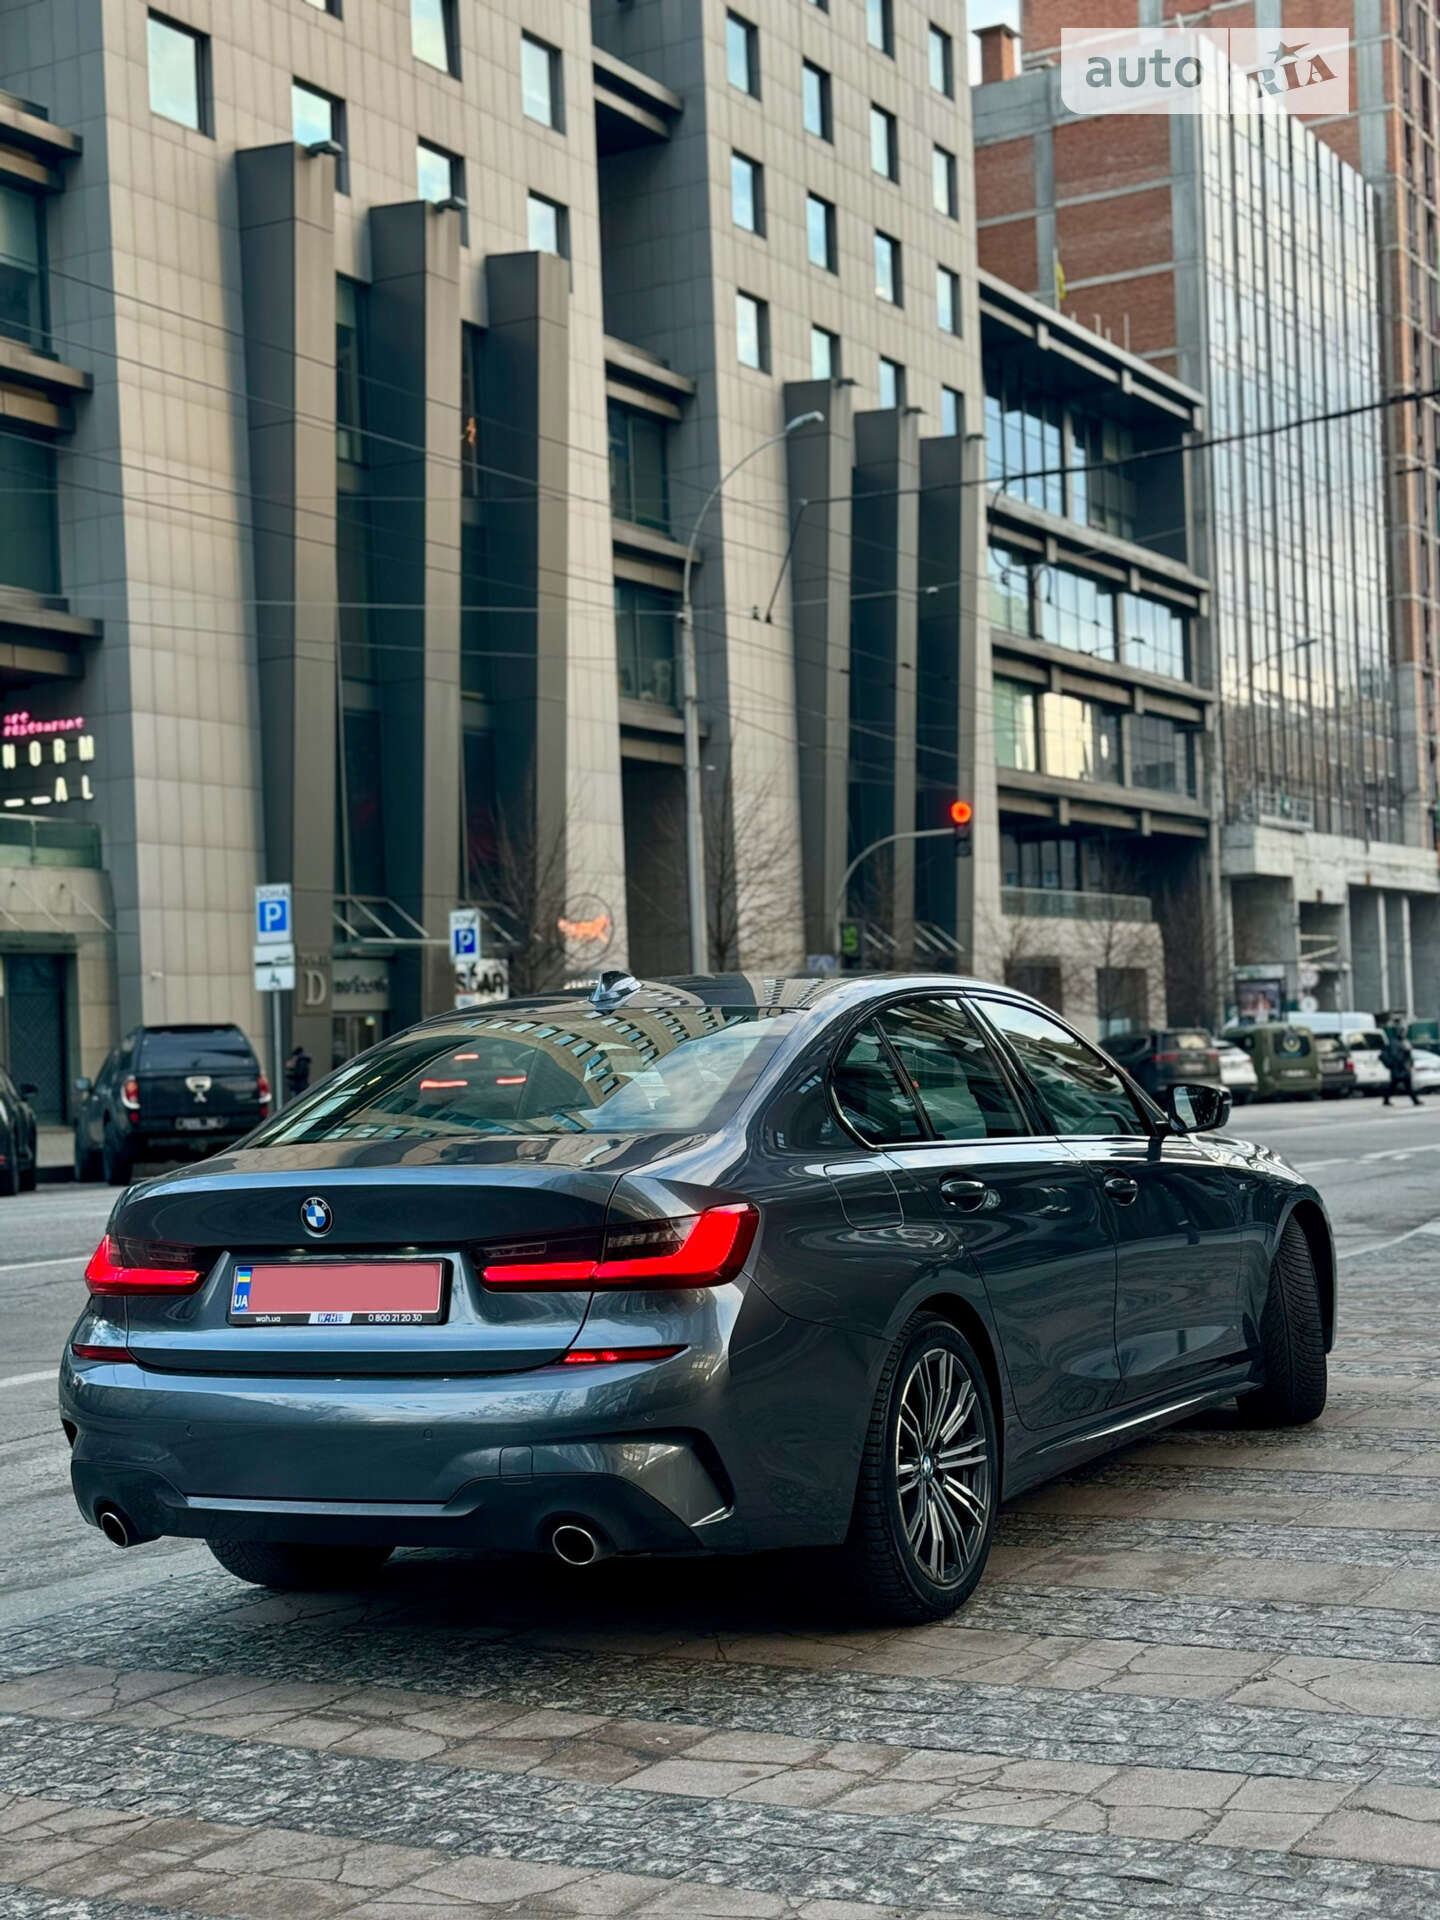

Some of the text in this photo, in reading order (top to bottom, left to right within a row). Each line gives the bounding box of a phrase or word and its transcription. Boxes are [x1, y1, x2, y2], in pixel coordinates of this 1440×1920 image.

[265, 902, 283, 932] P
[458, 930, 473, 954] P
[234, 1294, 248, 1308] UA
[255, 1314, 281, 1323] wah.ua
[367, 1313, 423, 1323] 0 800 21 20 30
